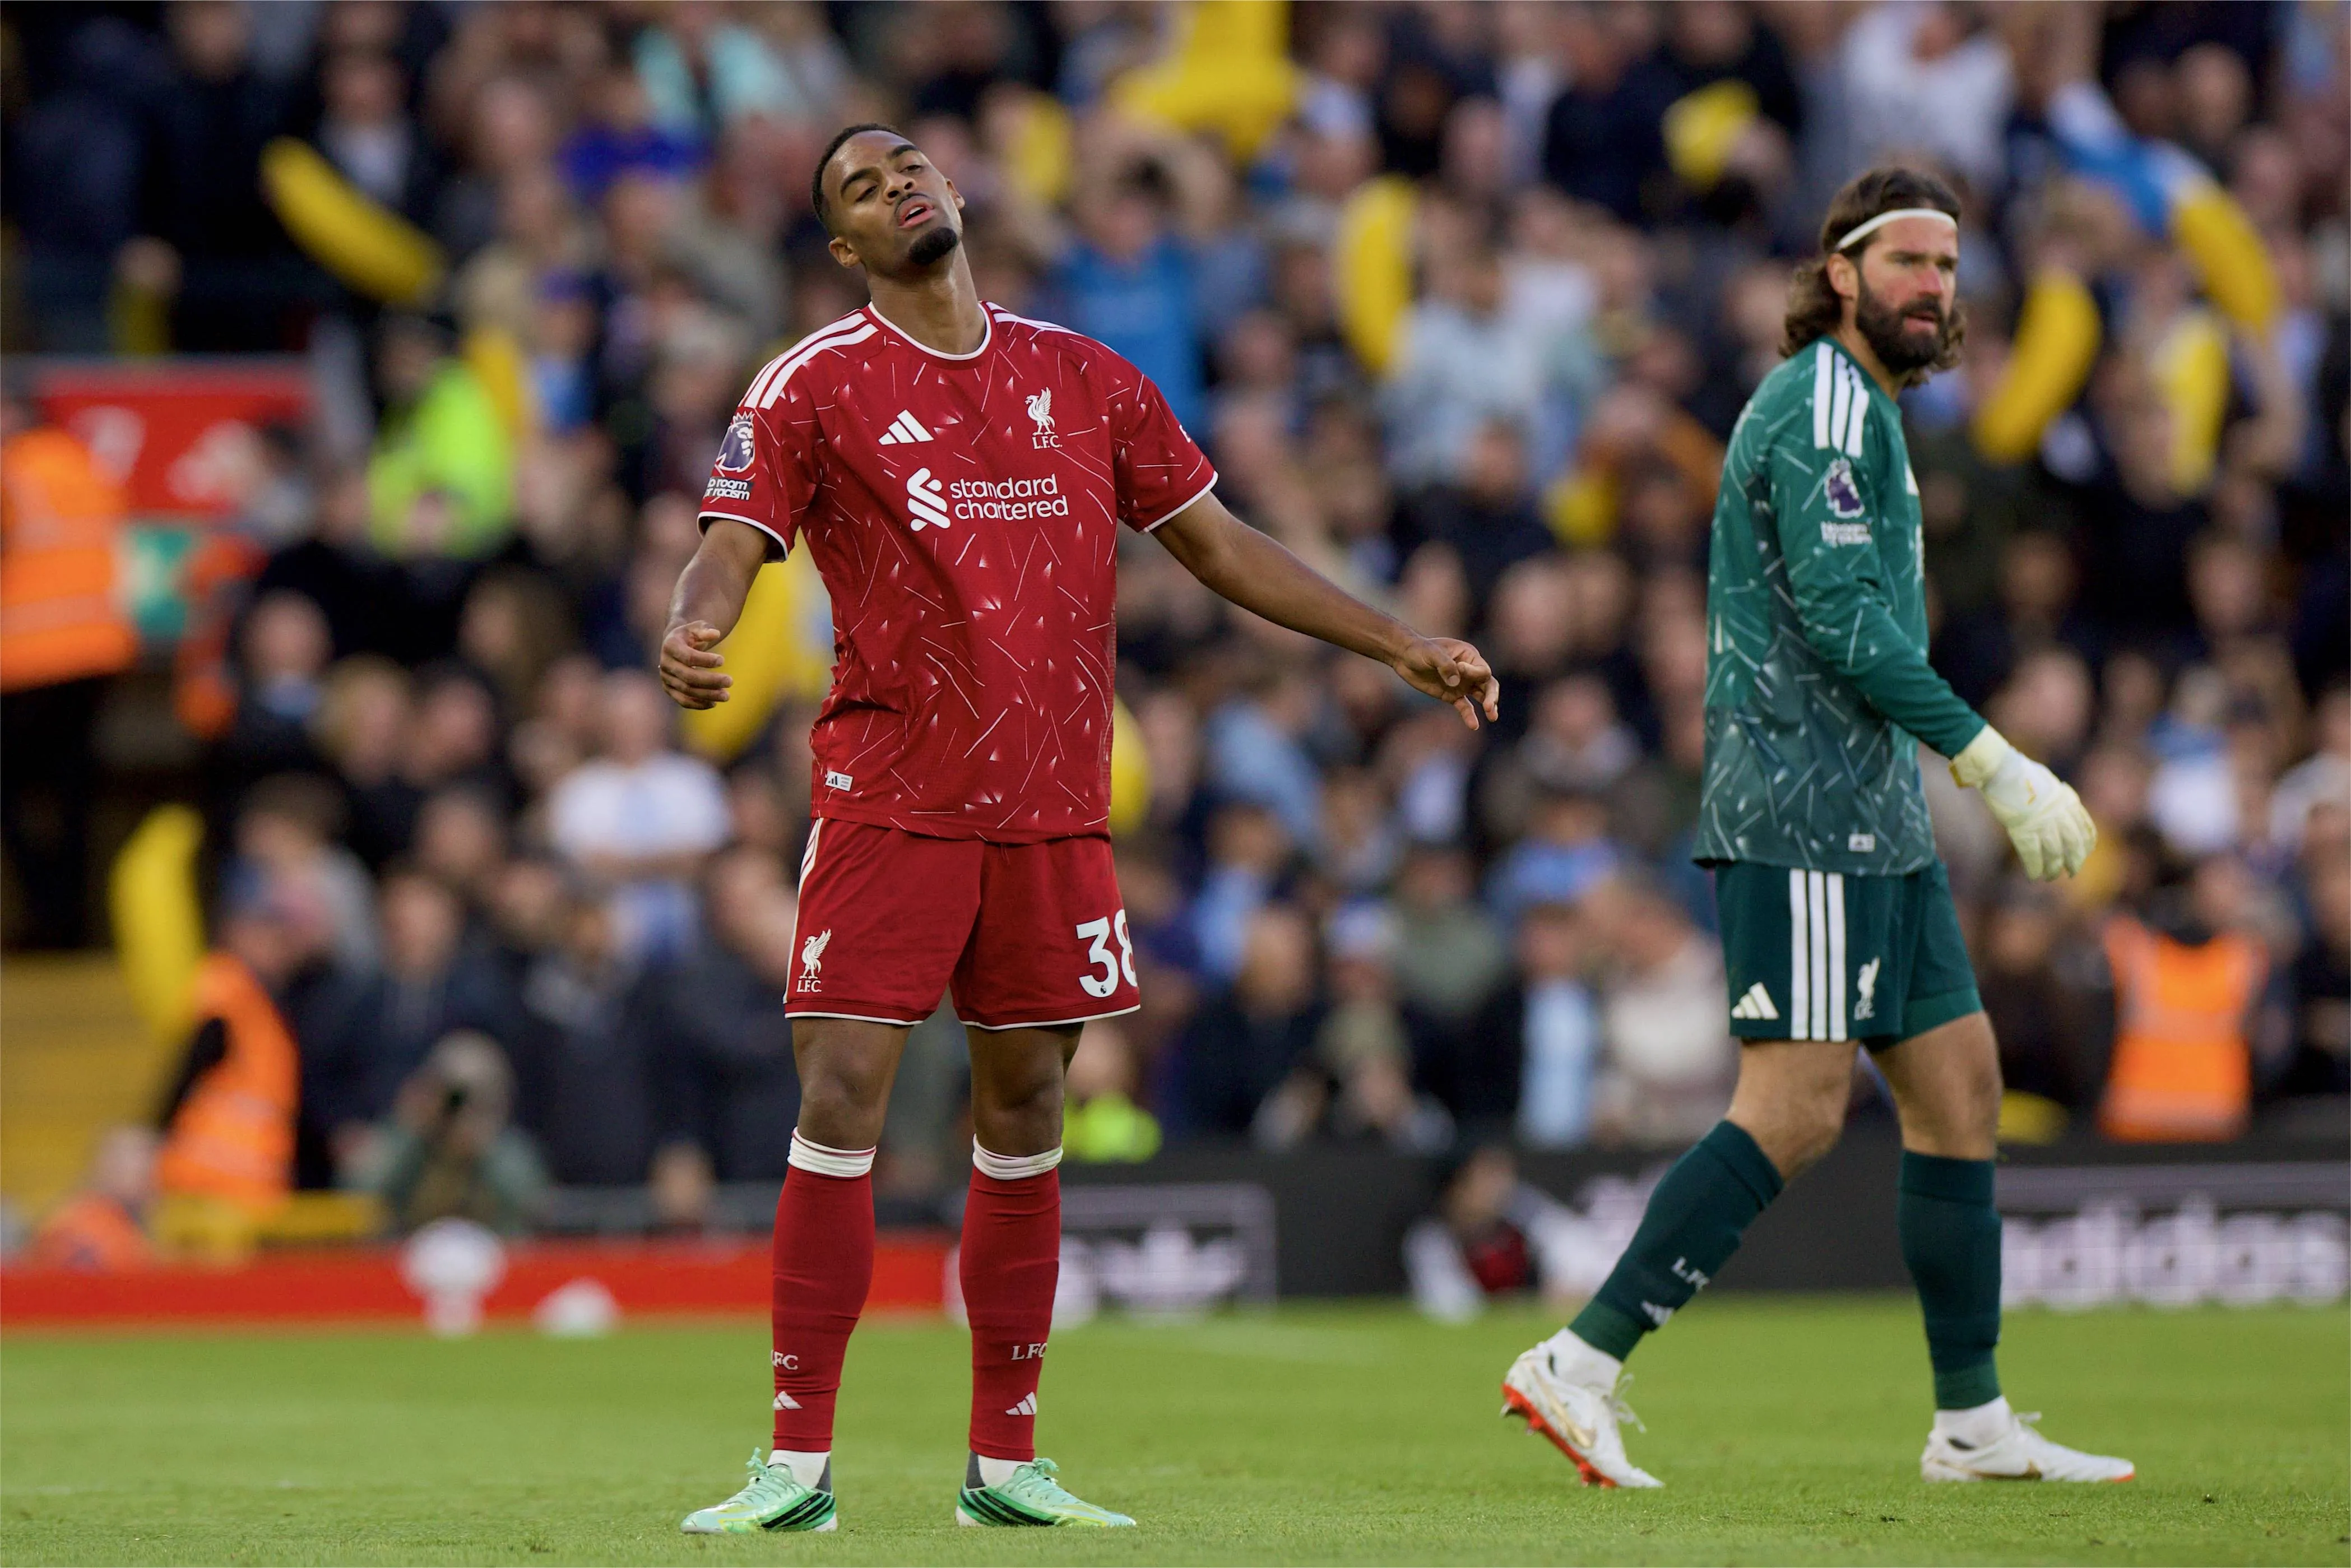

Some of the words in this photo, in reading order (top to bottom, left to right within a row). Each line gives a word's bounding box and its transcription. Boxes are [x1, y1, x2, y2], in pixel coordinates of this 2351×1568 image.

[716, 479, 748, 491] room
[949, 473, 1058, 499] standard
[954, 495, 1069, 521] chartered
[1075, 908, 1138, 998] 38
